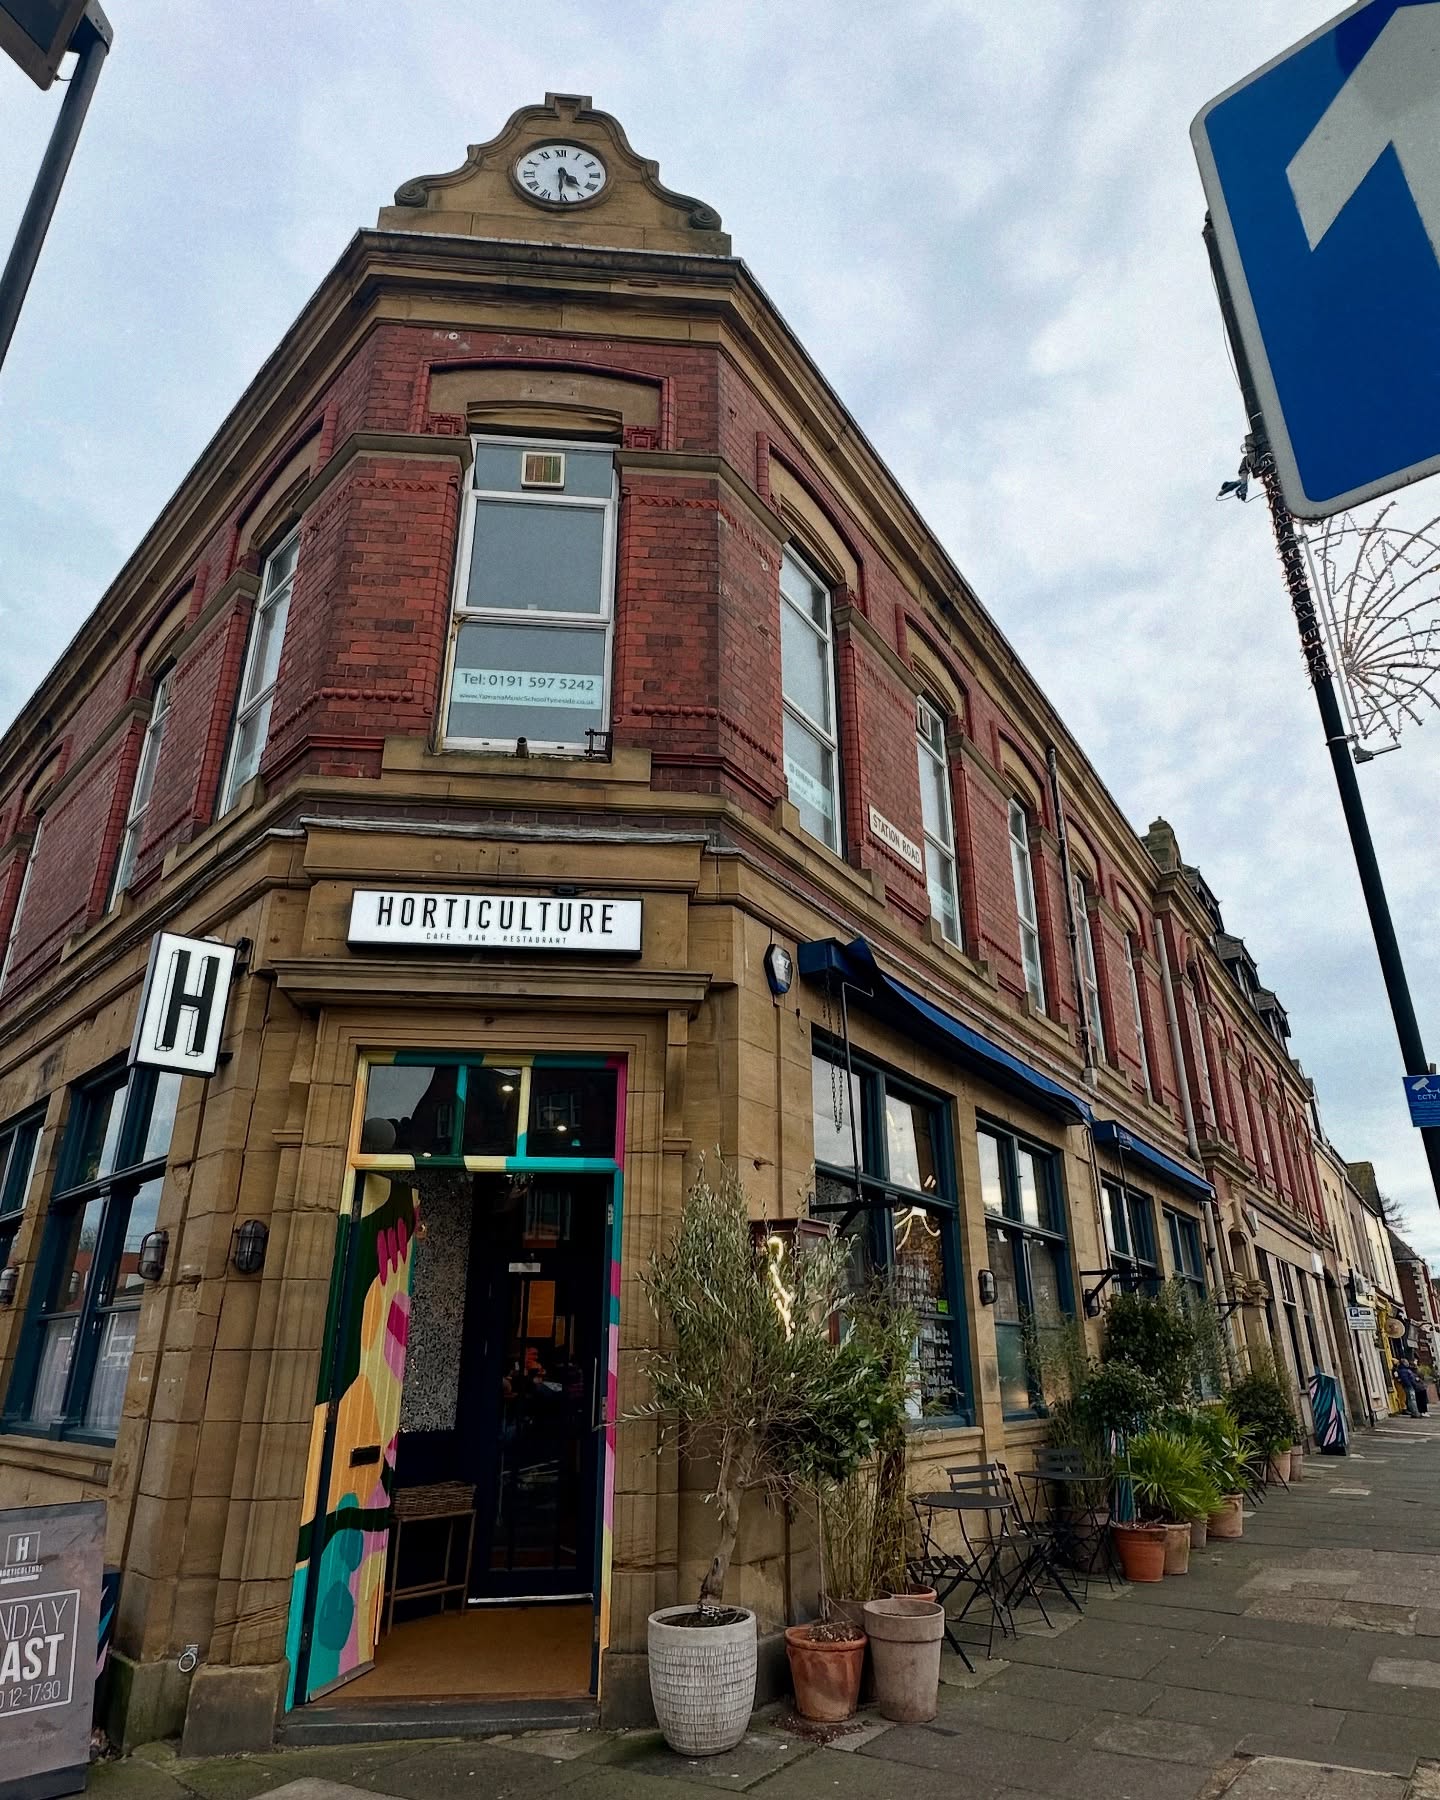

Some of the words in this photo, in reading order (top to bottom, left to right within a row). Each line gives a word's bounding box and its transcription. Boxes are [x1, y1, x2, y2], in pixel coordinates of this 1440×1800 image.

[538, 151, 551, 160] XI
[555, 149, 567, 157] XII
[488, 674, 522, 687] 0191
[528, 676, 556, 689] 597
[559, 678, 595, 691] 5242
[872, 813, 901, 848] STATION
[902, 839, 921, 865] ROAD
[376, 896, 614, 933] HORTICULTURE
[426, 932, 451, 941] CAFE
[468, 934, 486, 942] BAR
[503, 935, 567, 944] RESTAURANT
[154, 949, 220, 1057] H
[15, 1536, 30, 1562] H
